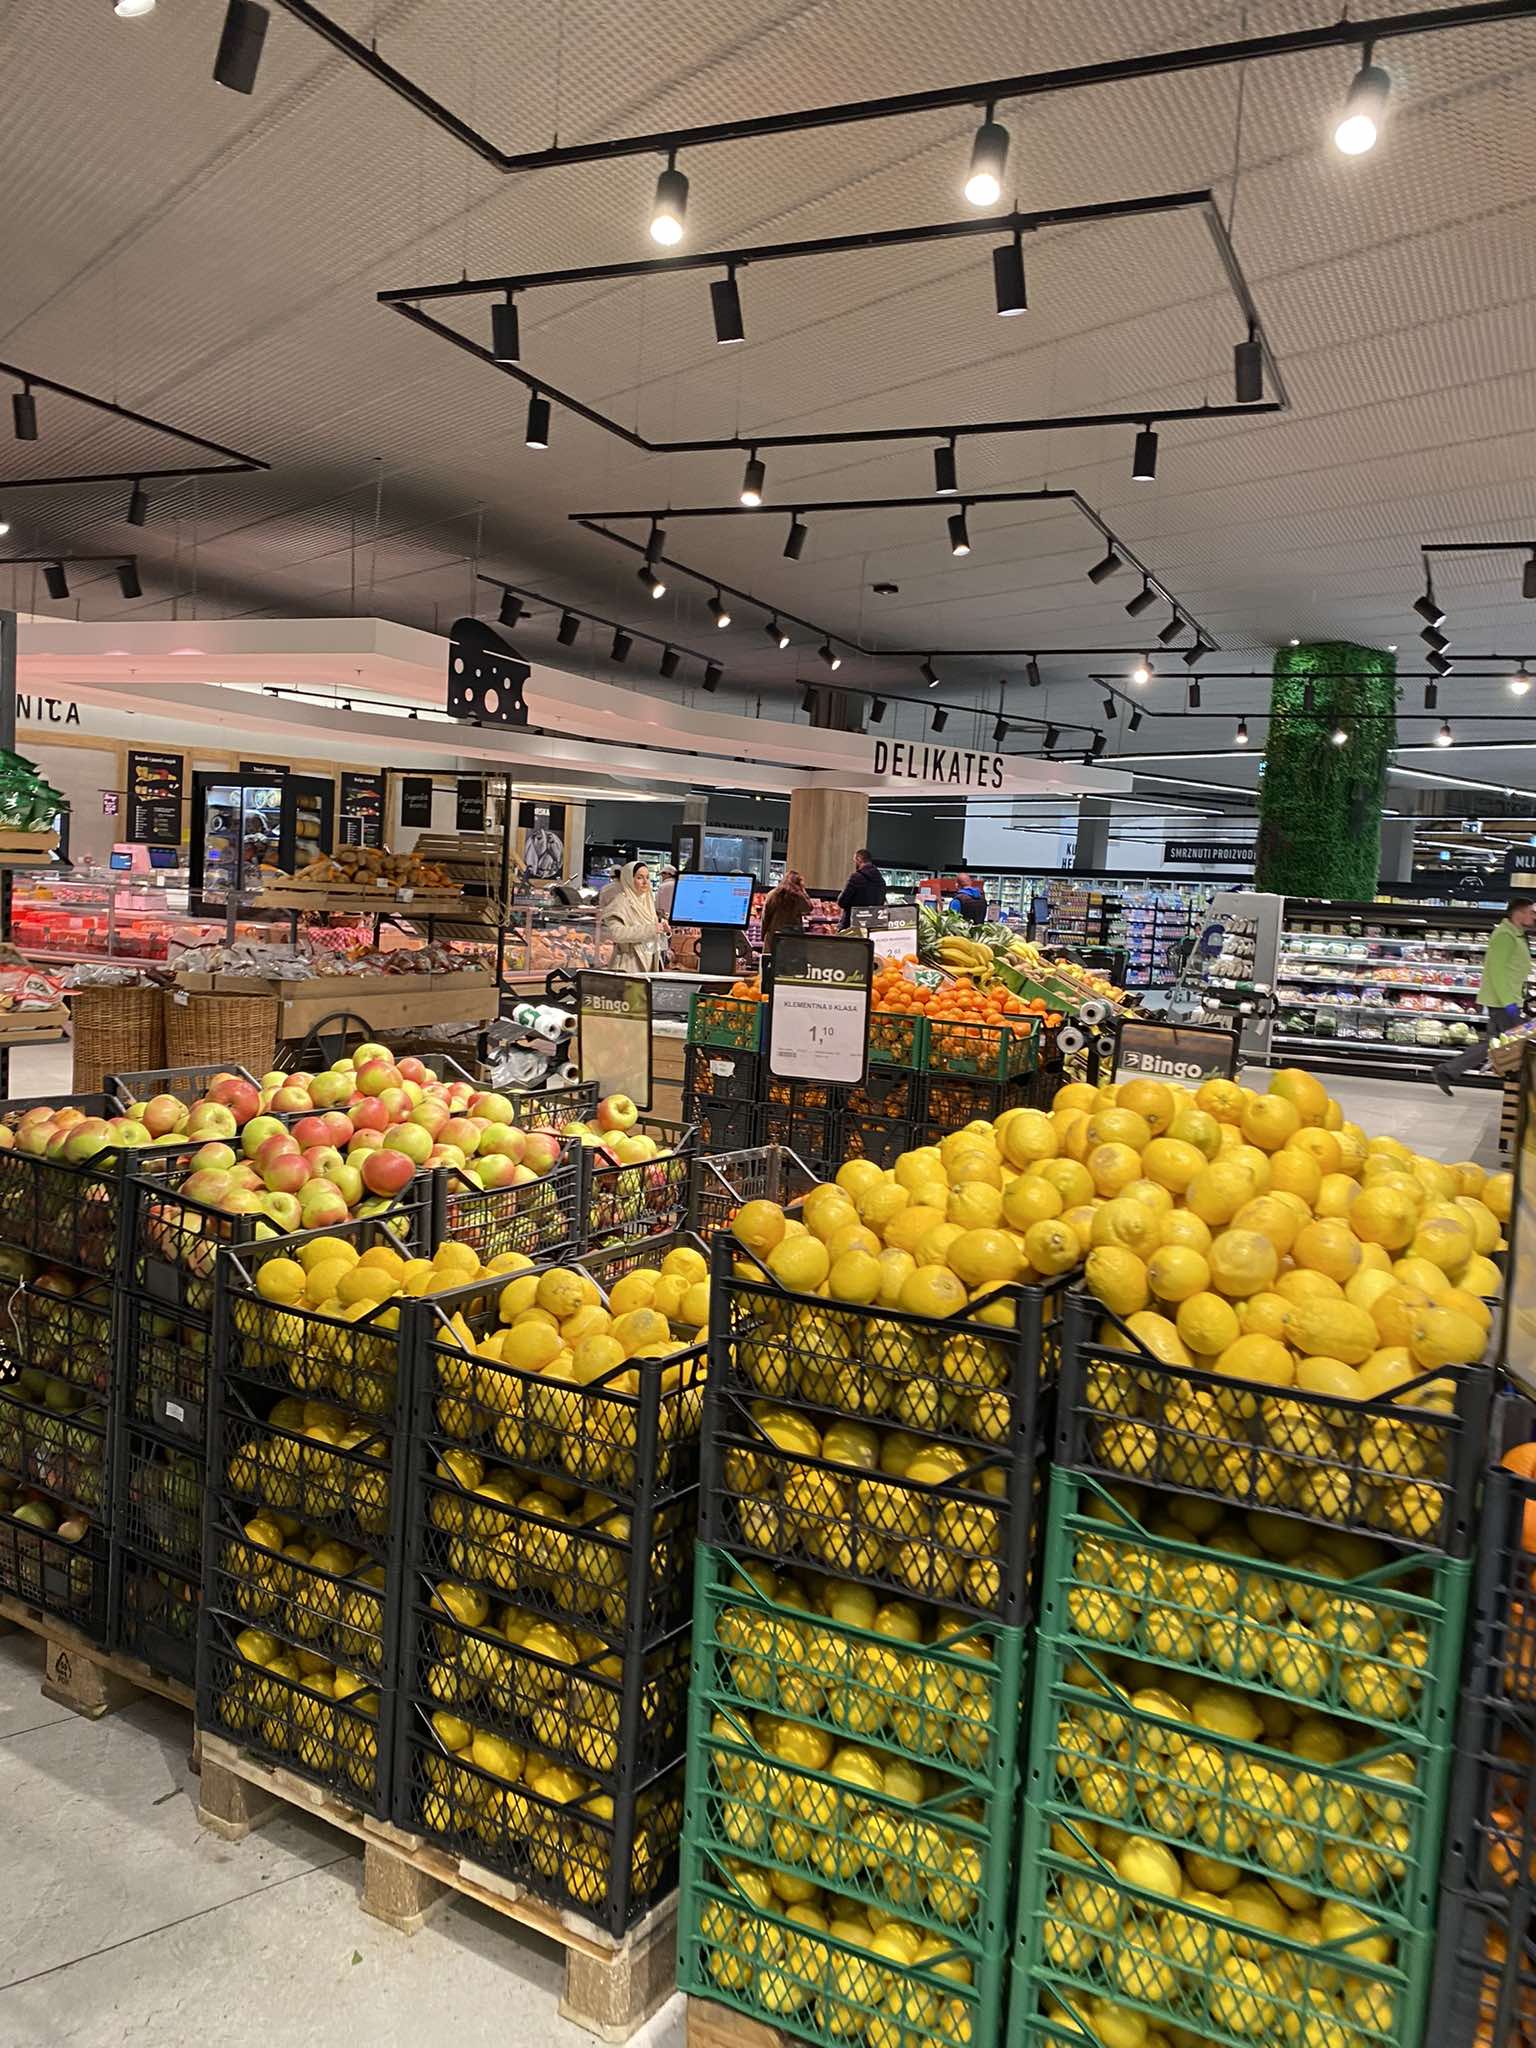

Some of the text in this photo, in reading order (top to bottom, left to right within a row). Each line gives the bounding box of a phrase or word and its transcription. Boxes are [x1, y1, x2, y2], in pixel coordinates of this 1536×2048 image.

[873, 740, 1004, 788] DELIKATES
[1170, 847, 1212, 859] SMRZNUTI
[794, 964, 846, 983] ingo
[592, 995, 630, 1013] Bingo
[784, 1001, 827, 1010] KLEMENTINA
[1141, 1054, 1203, 1079] Bingo
